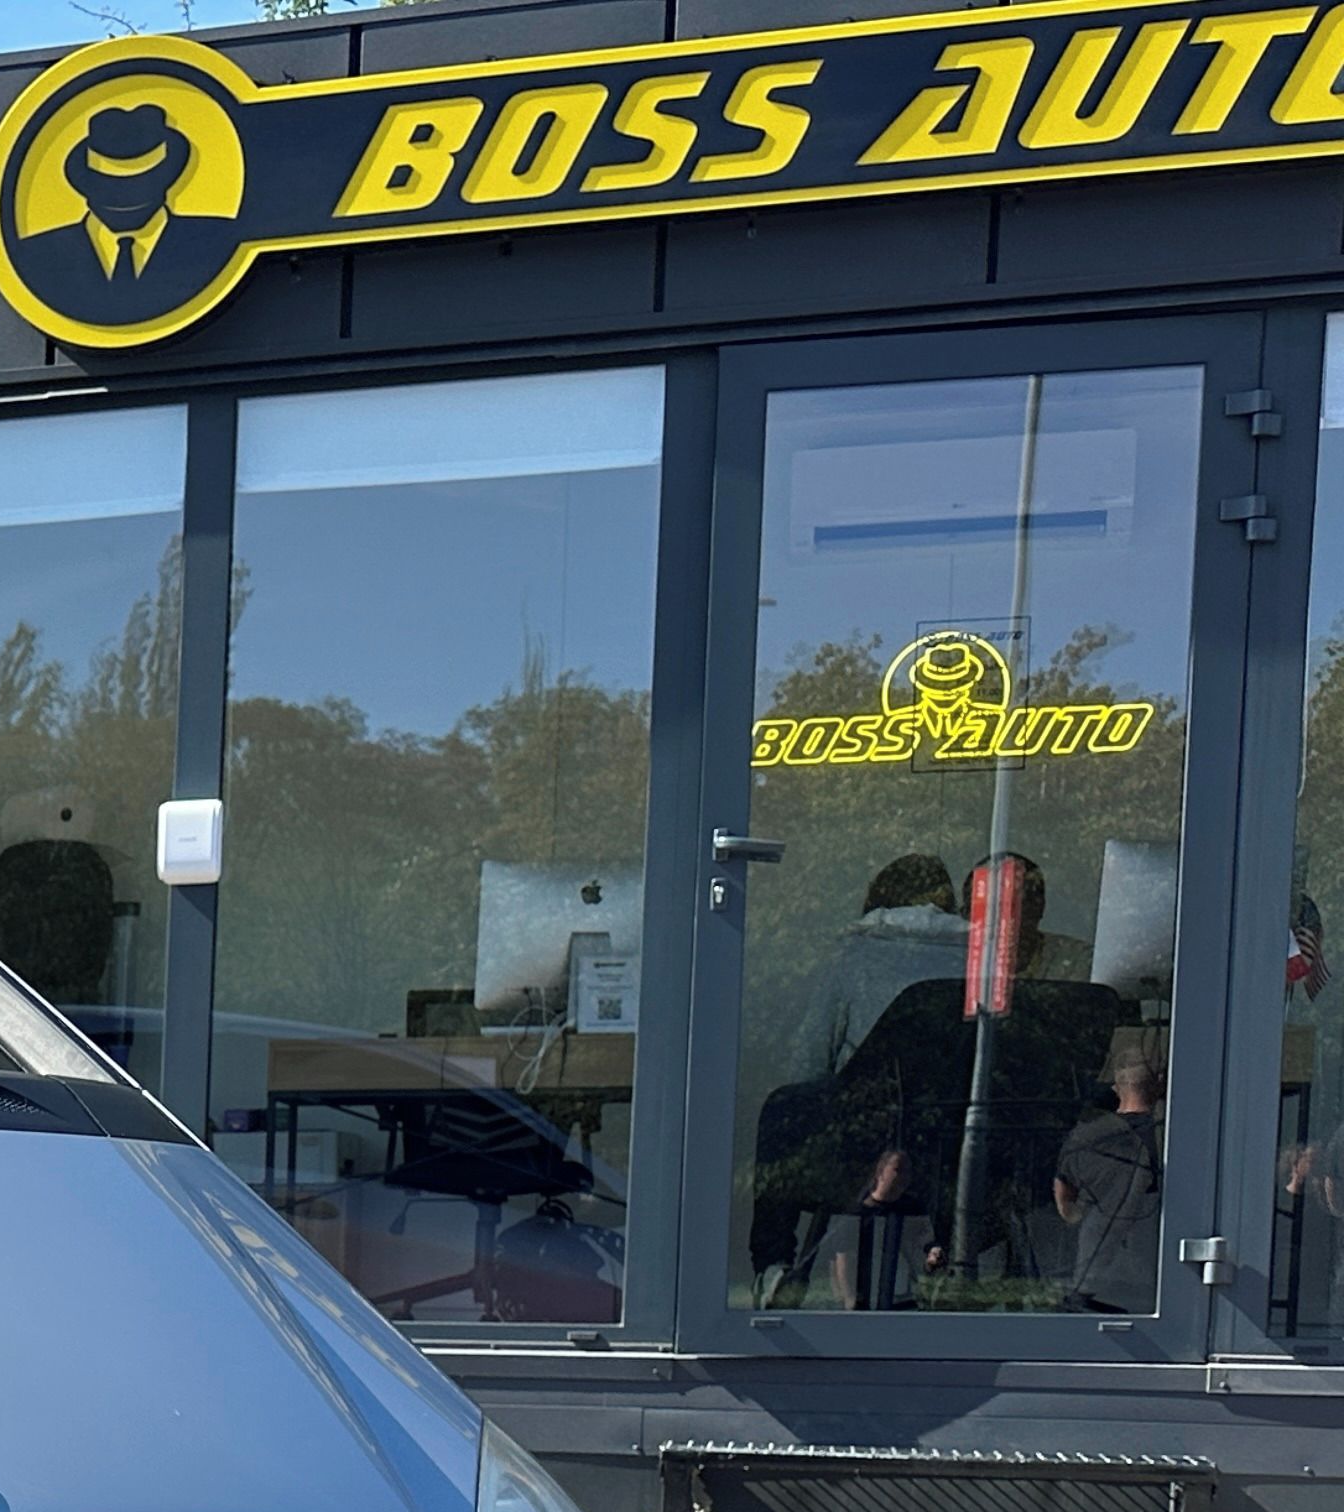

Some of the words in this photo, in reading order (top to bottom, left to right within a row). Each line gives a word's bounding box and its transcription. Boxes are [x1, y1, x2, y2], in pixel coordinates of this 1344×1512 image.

[332, 59, 824, 218] BOSS
[750, 714, 924, 767] BOSS
[934, 703, 1154, 759] AUTO
